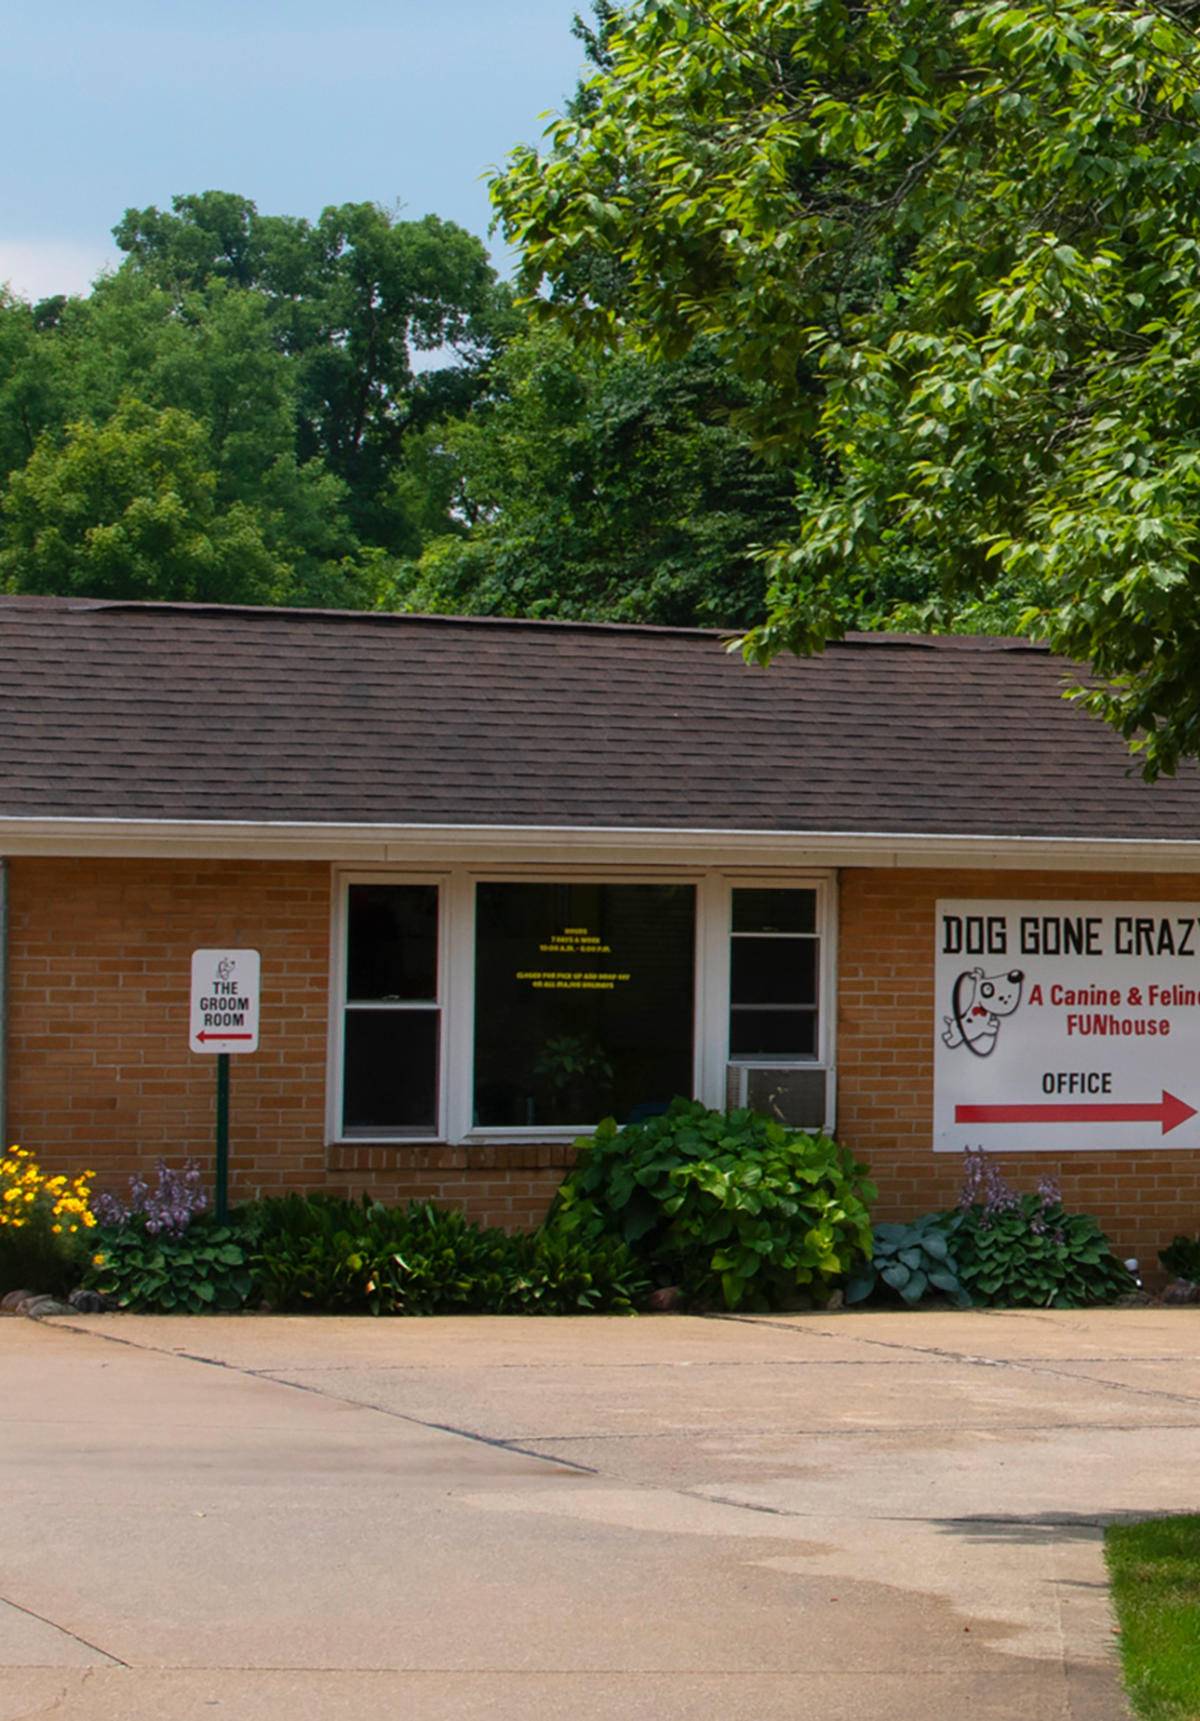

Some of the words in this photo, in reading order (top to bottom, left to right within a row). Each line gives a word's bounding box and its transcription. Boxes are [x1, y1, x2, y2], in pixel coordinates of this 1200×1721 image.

[943, 915, 1007, 955] DOG
[1020, 916, 1102, 956] GONE
[212, 981, 238, 995] THE
[1028, 984, 1043, 1006] A
[1051, 984, 1121, 1006] Canine
[1127, 985, 1142, 1006] &
[200, 997, 250, 1011] GROOM
[204, 1013, 245, 1027] ROOM
[1067, 1014, 1170, 1036] FUNhouse
[1042, 1072, 1112, 1094] OFFICE
